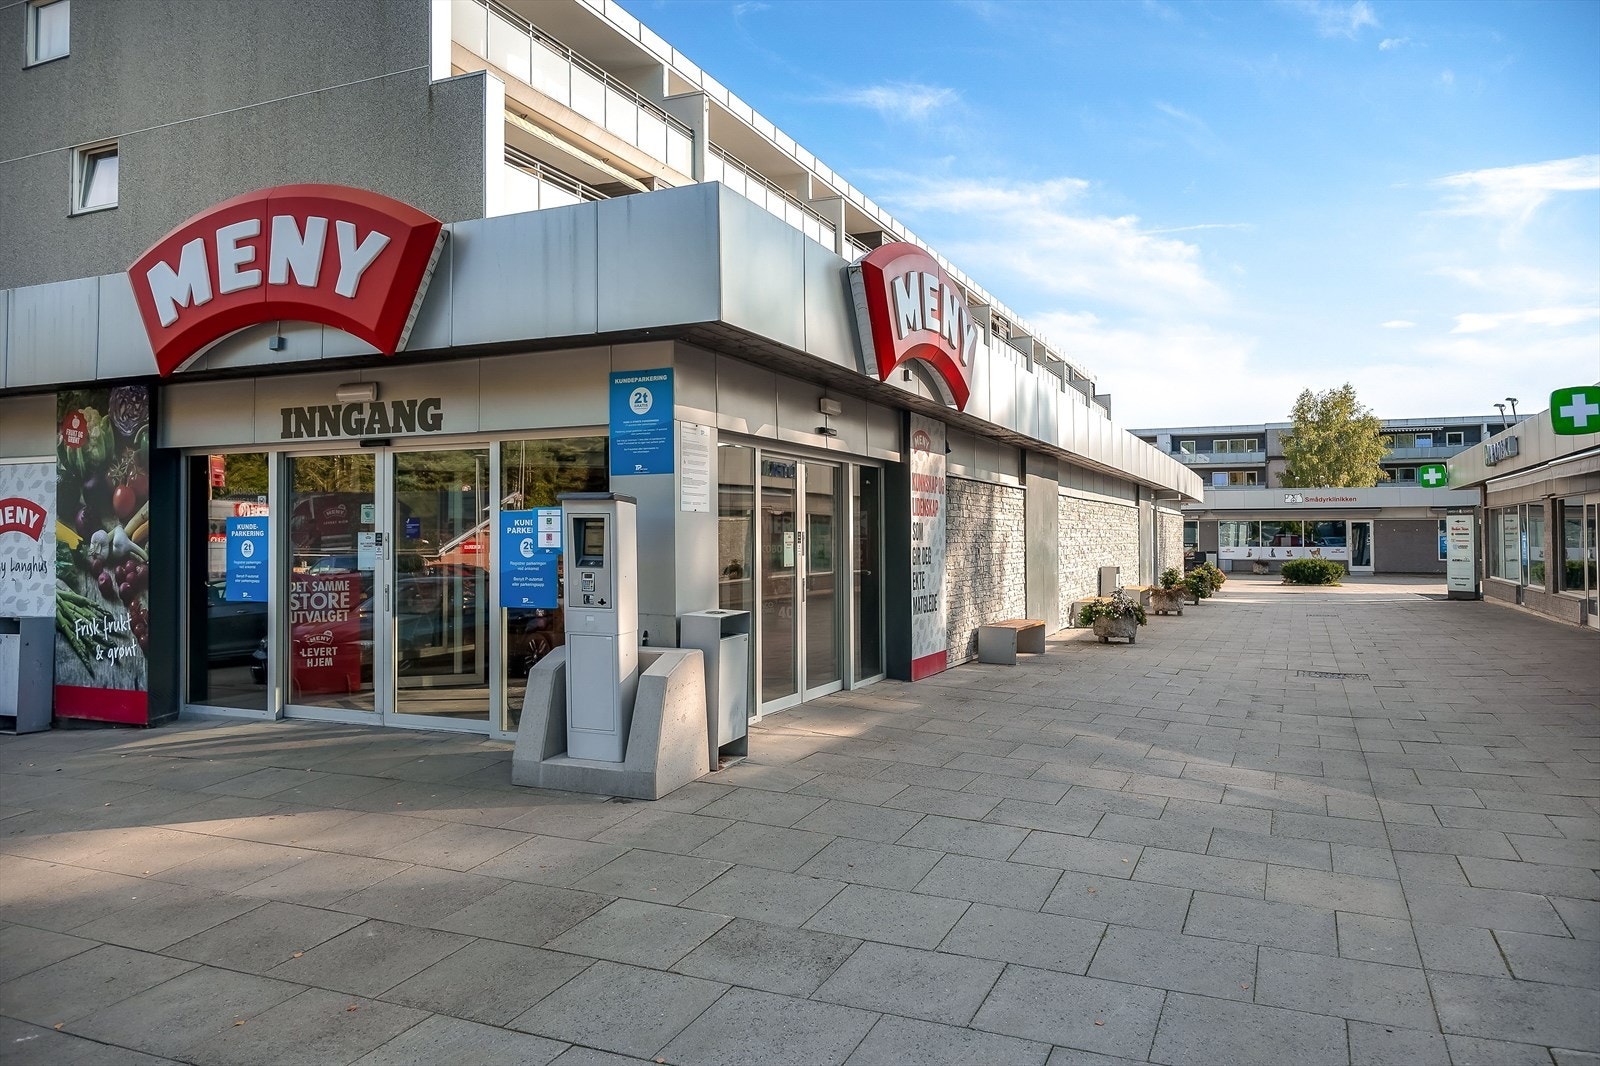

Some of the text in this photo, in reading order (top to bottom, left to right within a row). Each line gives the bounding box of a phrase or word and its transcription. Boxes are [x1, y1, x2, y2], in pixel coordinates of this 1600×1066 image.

[146, 214, 391, 327] MENY
[891, 270, 976, 367] MENY
[614, 375, 668, 384] KUNDEPARKERING
[634, 392, 648, 404] 2t
[280, 397, 444, 439] INNGANG
[914, 435, 930, 449] MENY
[912, 473, 938, 493] KUNNSKAP
[912, 498, 938, 517] LIDENSKAP
[1304, 495, 1357, 504] Smådyrklinikken
[912, 522, 924, 541] SOM
[922, 546, 931, 565] DEG
[10, 557, 48, 579] Langhus
[311, 580, 350, 592] SAMME
[912, 571, 925, 590] EKTE
[290, 592, 350, 610] STORE
[912, 594, 938, 615] MATGLEDE
[75, 612, 132, 640] Frisk frukt
[290, 609, 350, 624] UTVALGET
[309, 635, 330, 643] MENY
[96, 640, 137, 667] & grønt
[301, 646, 338, 657] LEVERT
[306, 657, 333, 667] HJEM
